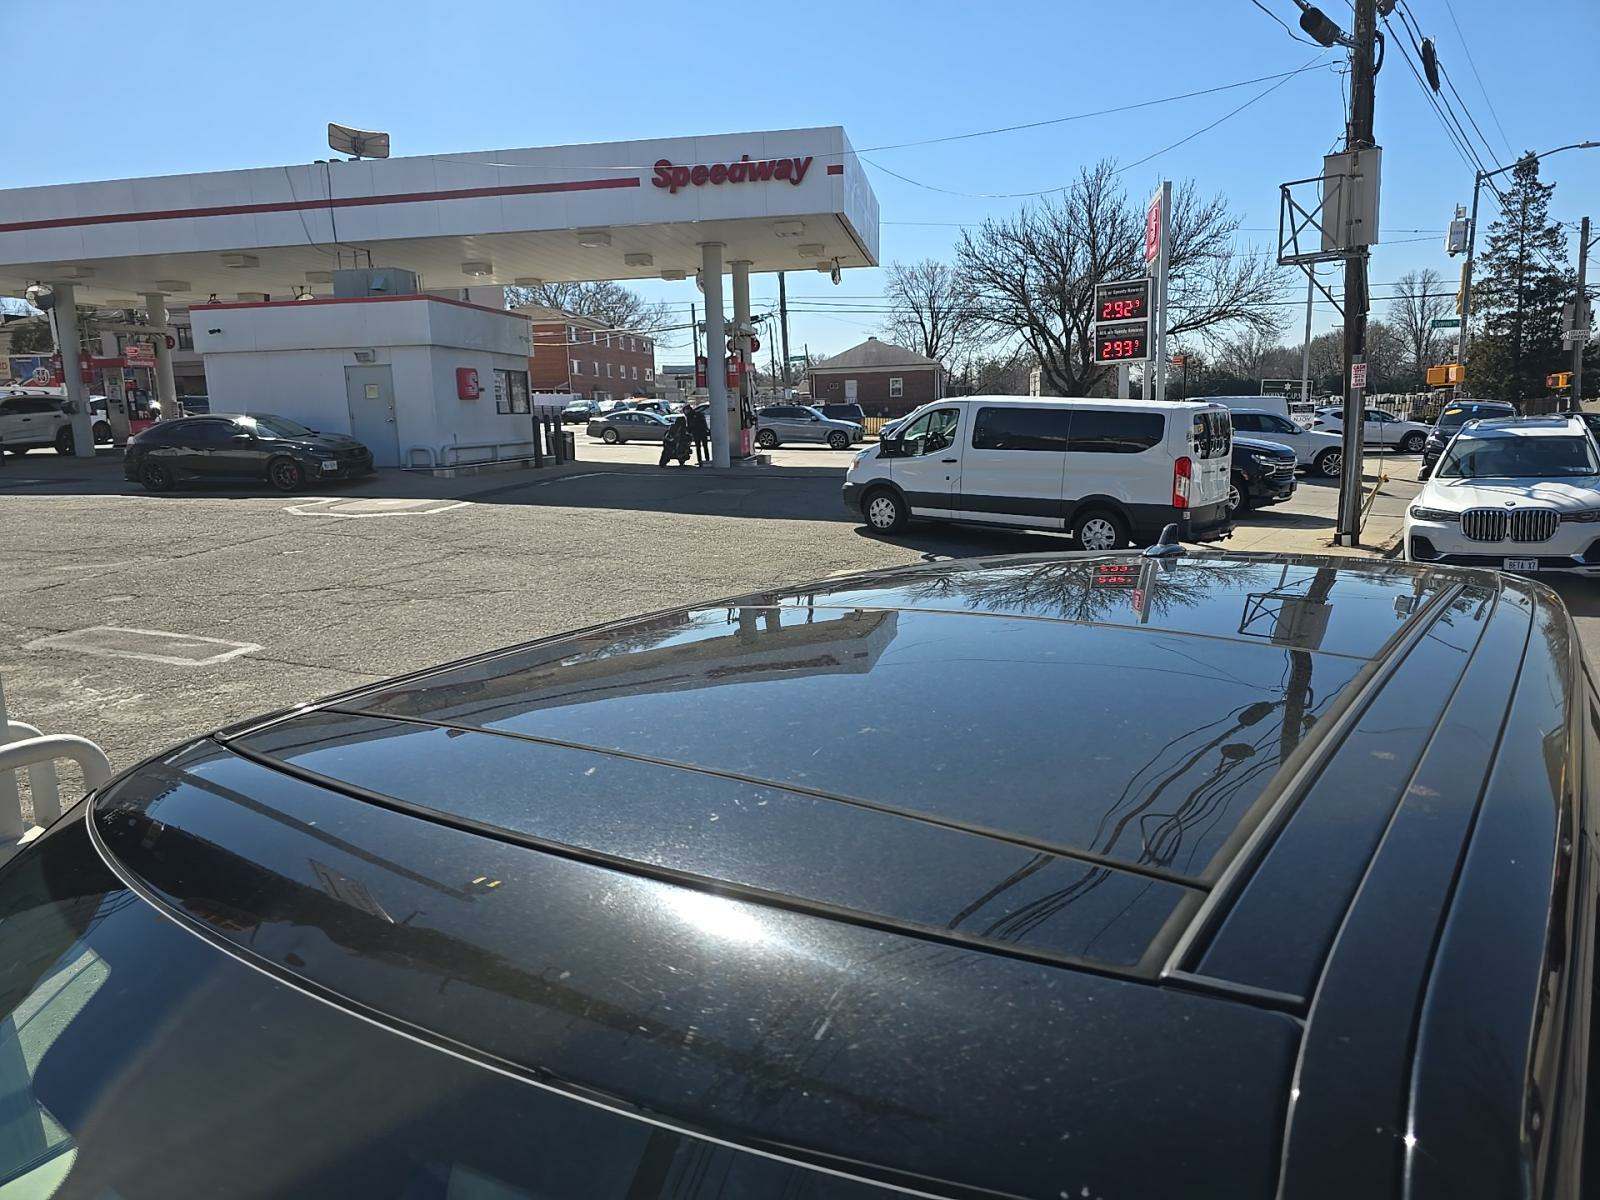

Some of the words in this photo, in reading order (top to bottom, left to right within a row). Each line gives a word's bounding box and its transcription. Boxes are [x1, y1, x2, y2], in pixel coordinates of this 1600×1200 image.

[652, 155, 812, 193] Speedway
[1103, 300, 1132, 318] 2.92
[1103, 340, 1132, 358] 2.93
